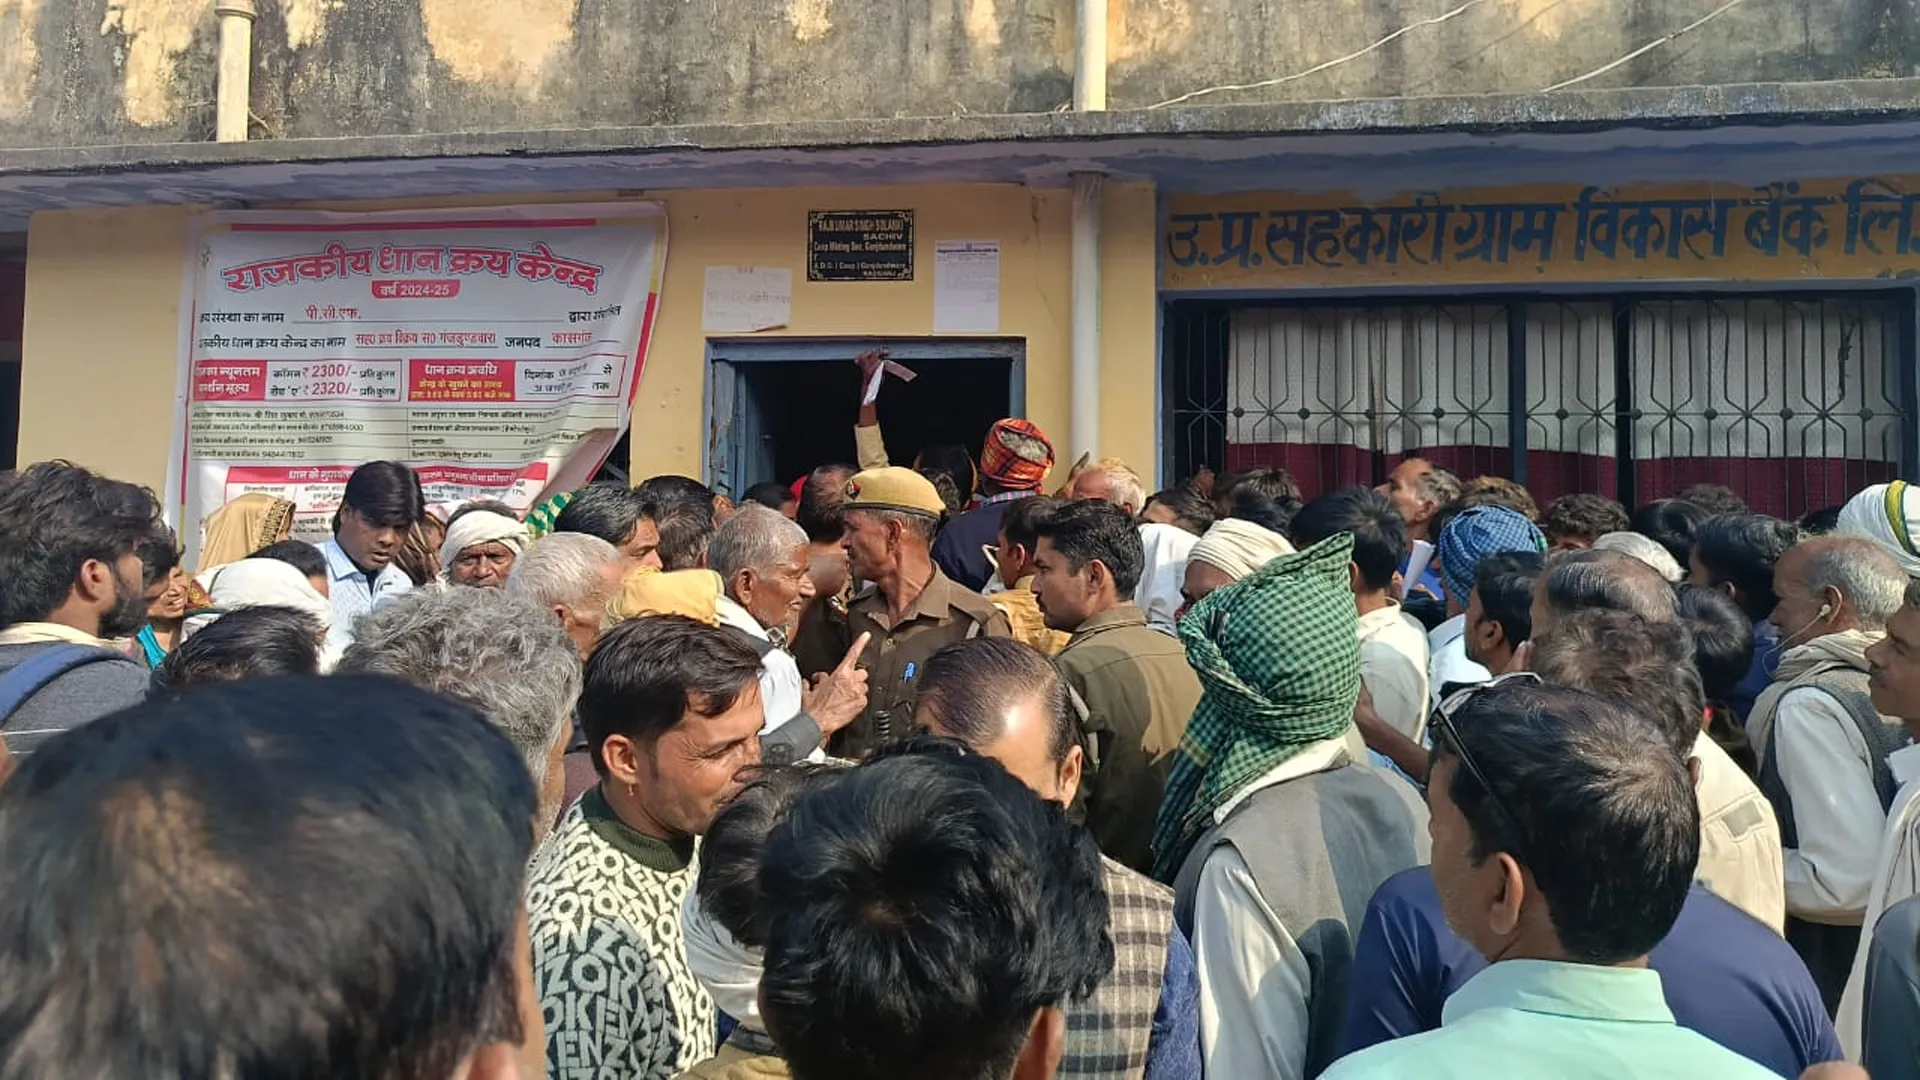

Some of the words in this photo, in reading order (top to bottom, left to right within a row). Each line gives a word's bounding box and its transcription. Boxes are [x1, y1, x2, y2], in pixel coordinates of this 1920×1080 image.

[1265, 190, 1453, 266] सहकारी
[1454, 203, 1568, 263] ग्राम
[1573, 187, 1737, 261] विकास
[1743, 181, 1836, 256] बैंक
[221, 241, 373, 292] राजकीय
[379, 244, 444, 273] धान
[447, 247, 511, 276] क्रय
[515, 240, 603, 295] केन्द्र
[400, 282, 450, 297] 2024-25
[261, 313, 284, 323] नाम
[255, 337, 278, 349] क्रय
[280, 333, 308, 349] केन्द्र
[326, 335, 347, 348] नाम
[504, 336, 541, 349] जनपद
[311, 363, 357, 378] 2300/-
[603, 364, 613, 375] से
[311, 381, 358, 396] 2320/-
